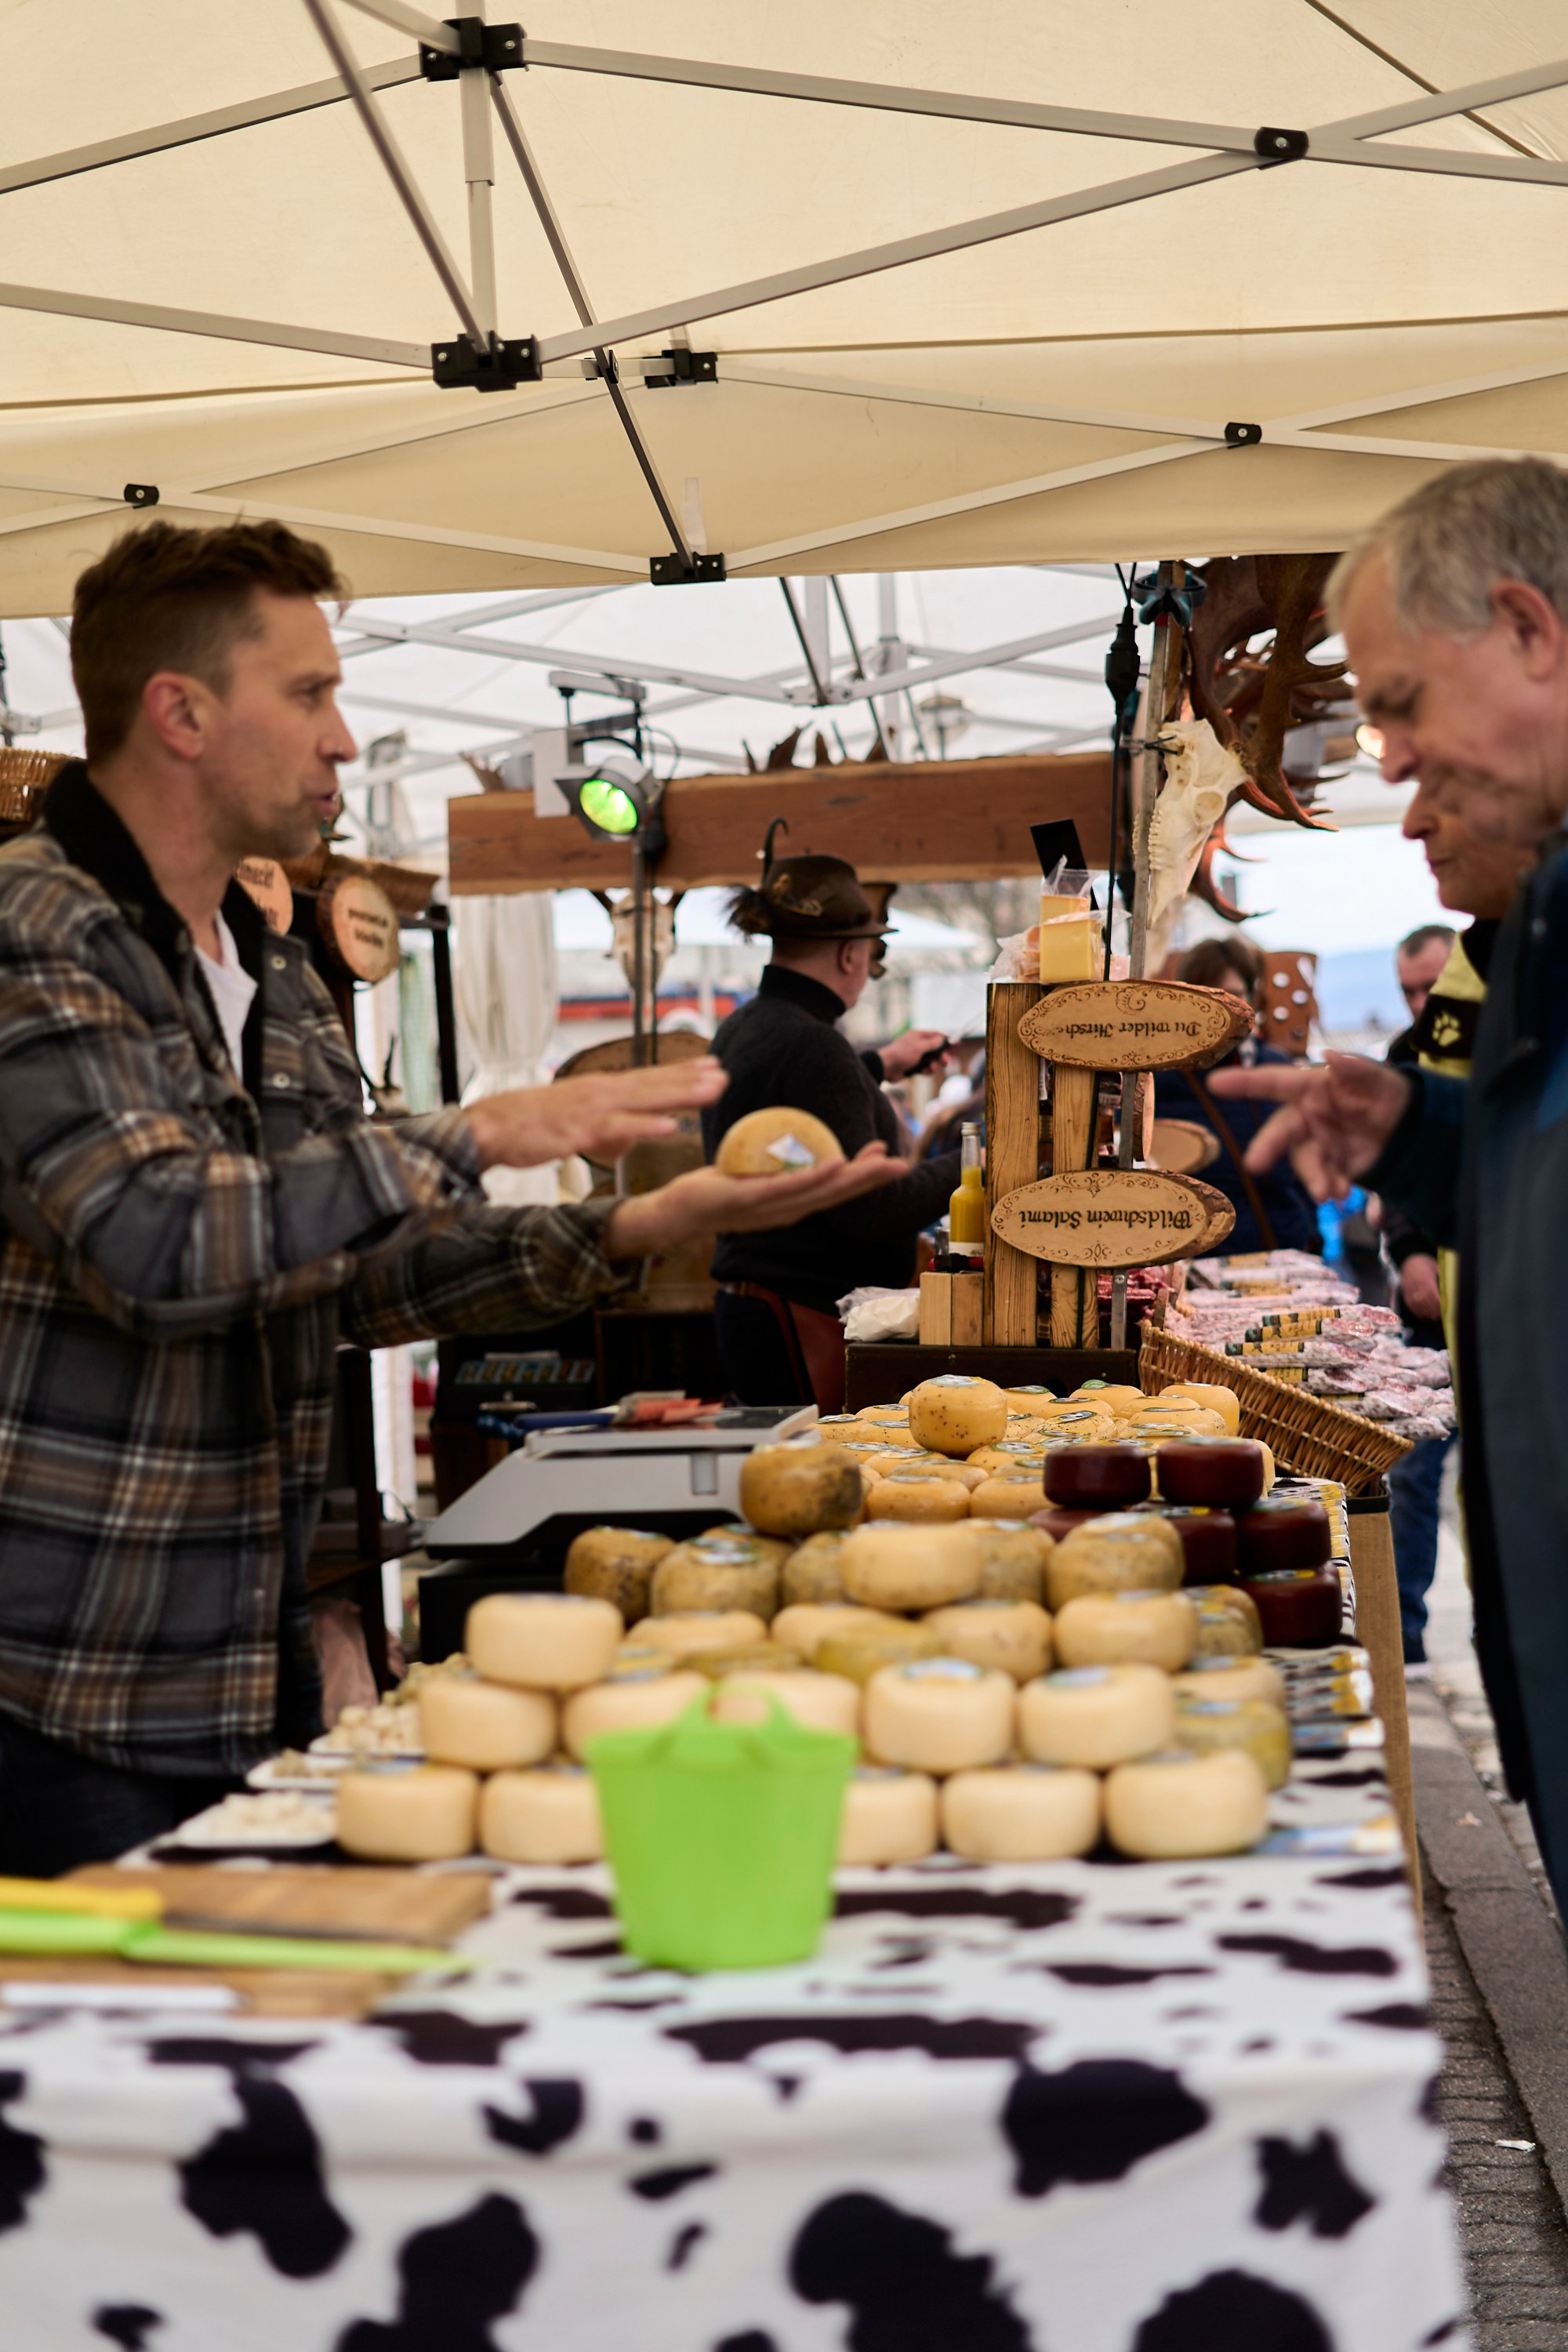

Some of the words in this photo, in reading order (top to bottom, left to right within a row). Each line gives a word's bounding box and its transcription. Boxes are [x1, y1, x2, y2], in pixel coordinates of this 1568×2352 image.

[1065, 1023, 1114, 1039] Hirsch
[1119, 1022, 1171, 1038] wilder
[1175, 1022, 1201, 1037] Du
[1018, 1210, 1083, 1229] Salami
[1086, 1210, 1192, 1229] Wildschwein
